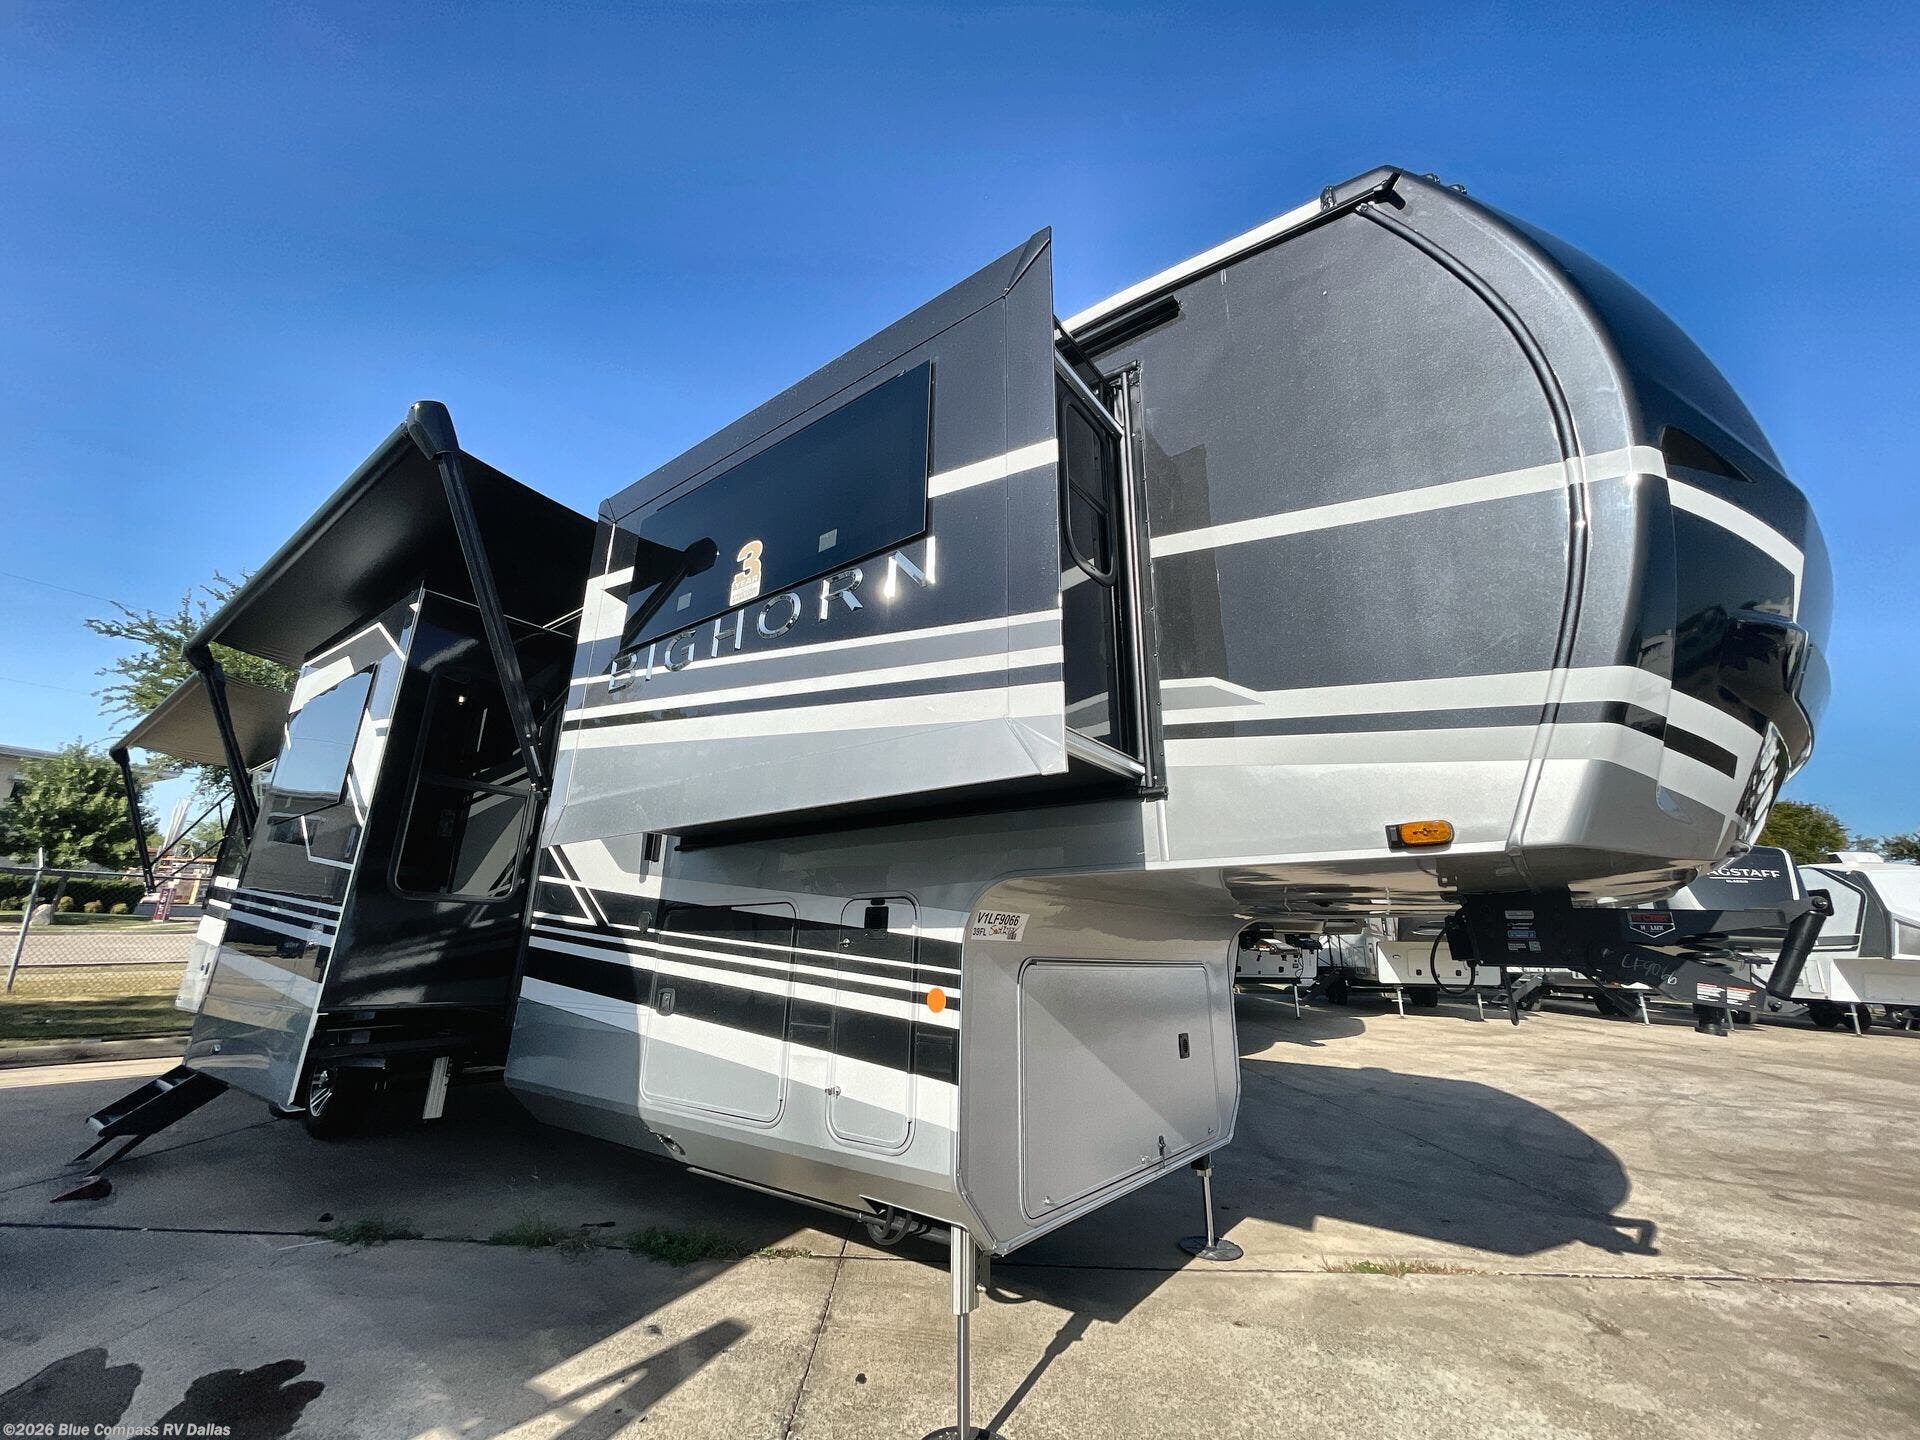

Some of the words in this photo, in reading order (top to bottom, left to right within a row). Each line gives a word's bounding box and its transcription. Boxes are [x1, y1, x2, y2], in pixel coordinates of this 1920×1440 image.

[736, 540, 763, 578] 3
[608, 536, 936, 694] BIGHORN
[1707, 868, 1781, 878] AGSTAFF
[977, 911, 1021, 926] V1LF9066
[972, 927, 987, 936] 39FL
